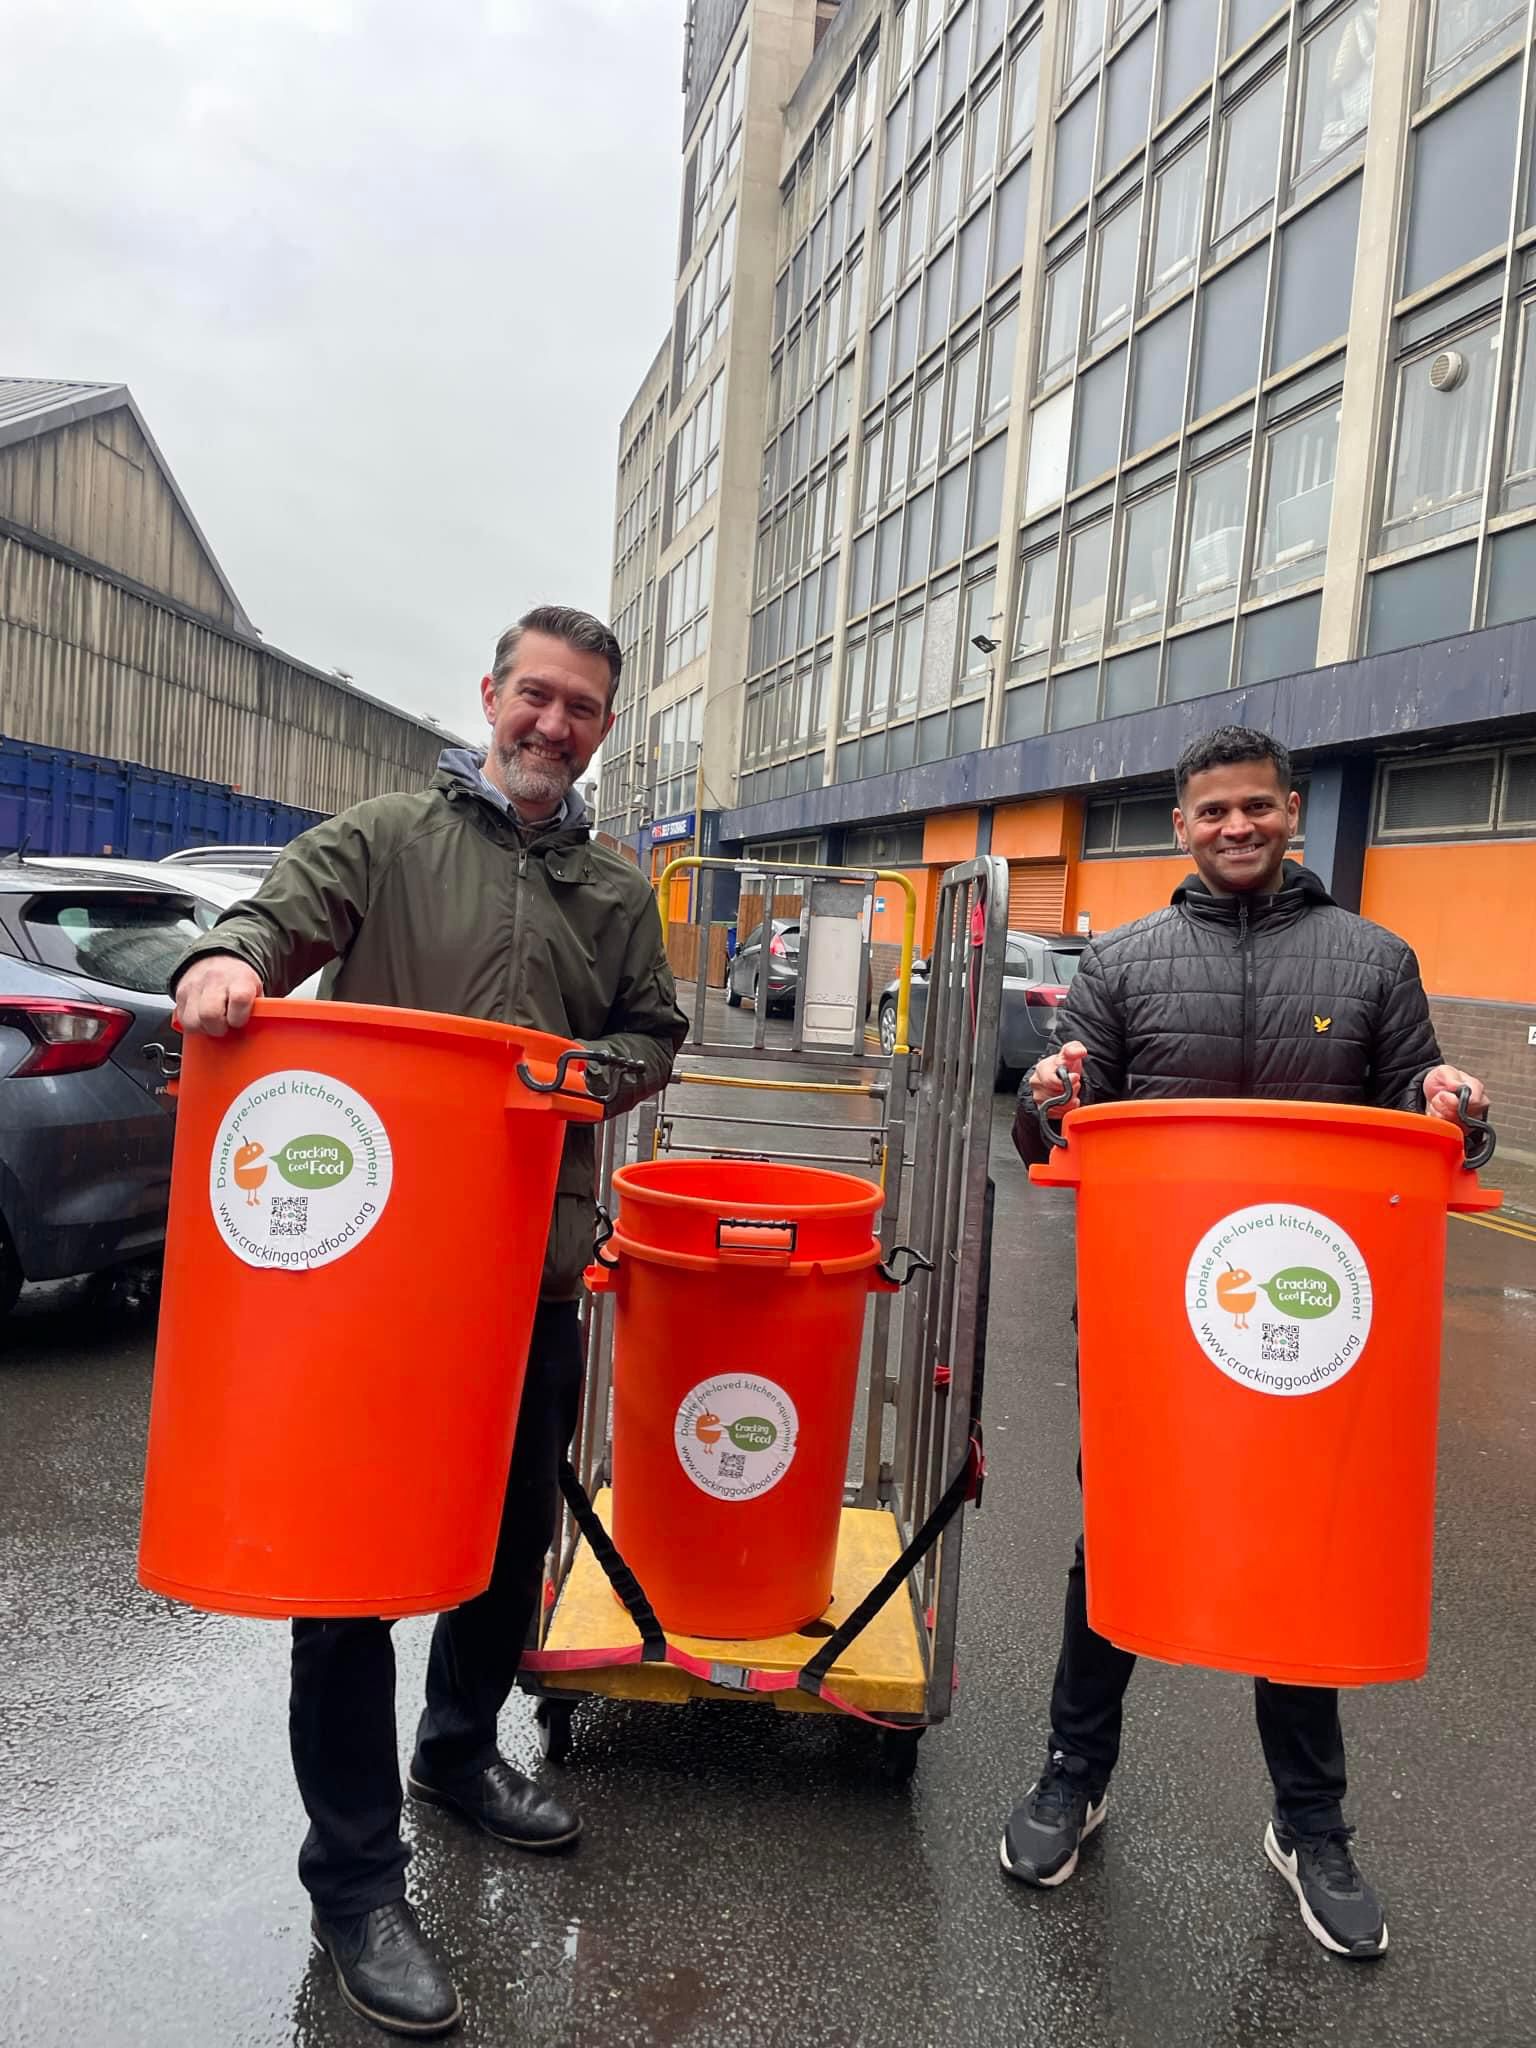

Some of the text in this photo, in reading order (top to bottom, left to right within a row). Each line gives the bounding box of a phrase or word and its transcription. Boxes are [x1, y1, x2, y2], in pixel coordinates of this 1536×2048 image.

[217, 1080, 378, 1188] Donate pre-loved kitchen equipment
[286, 1146, 338, 1161] Cracking
[309, 1160, 344, 1175] Food
[219, 1201, 376, 1265] www.crackinggoodfood.org
[1196, 1214, 1361, 1320] Donate pre-loved kitchen equipment
[1275, 1277, 1327, 1292] Cracking
[1300, 1291, 1333, 1308] Food
[1200, 1322, 1361, 1391] www.crackinggoodfood.org
[744, 1380, 777, 1403] kitchen
